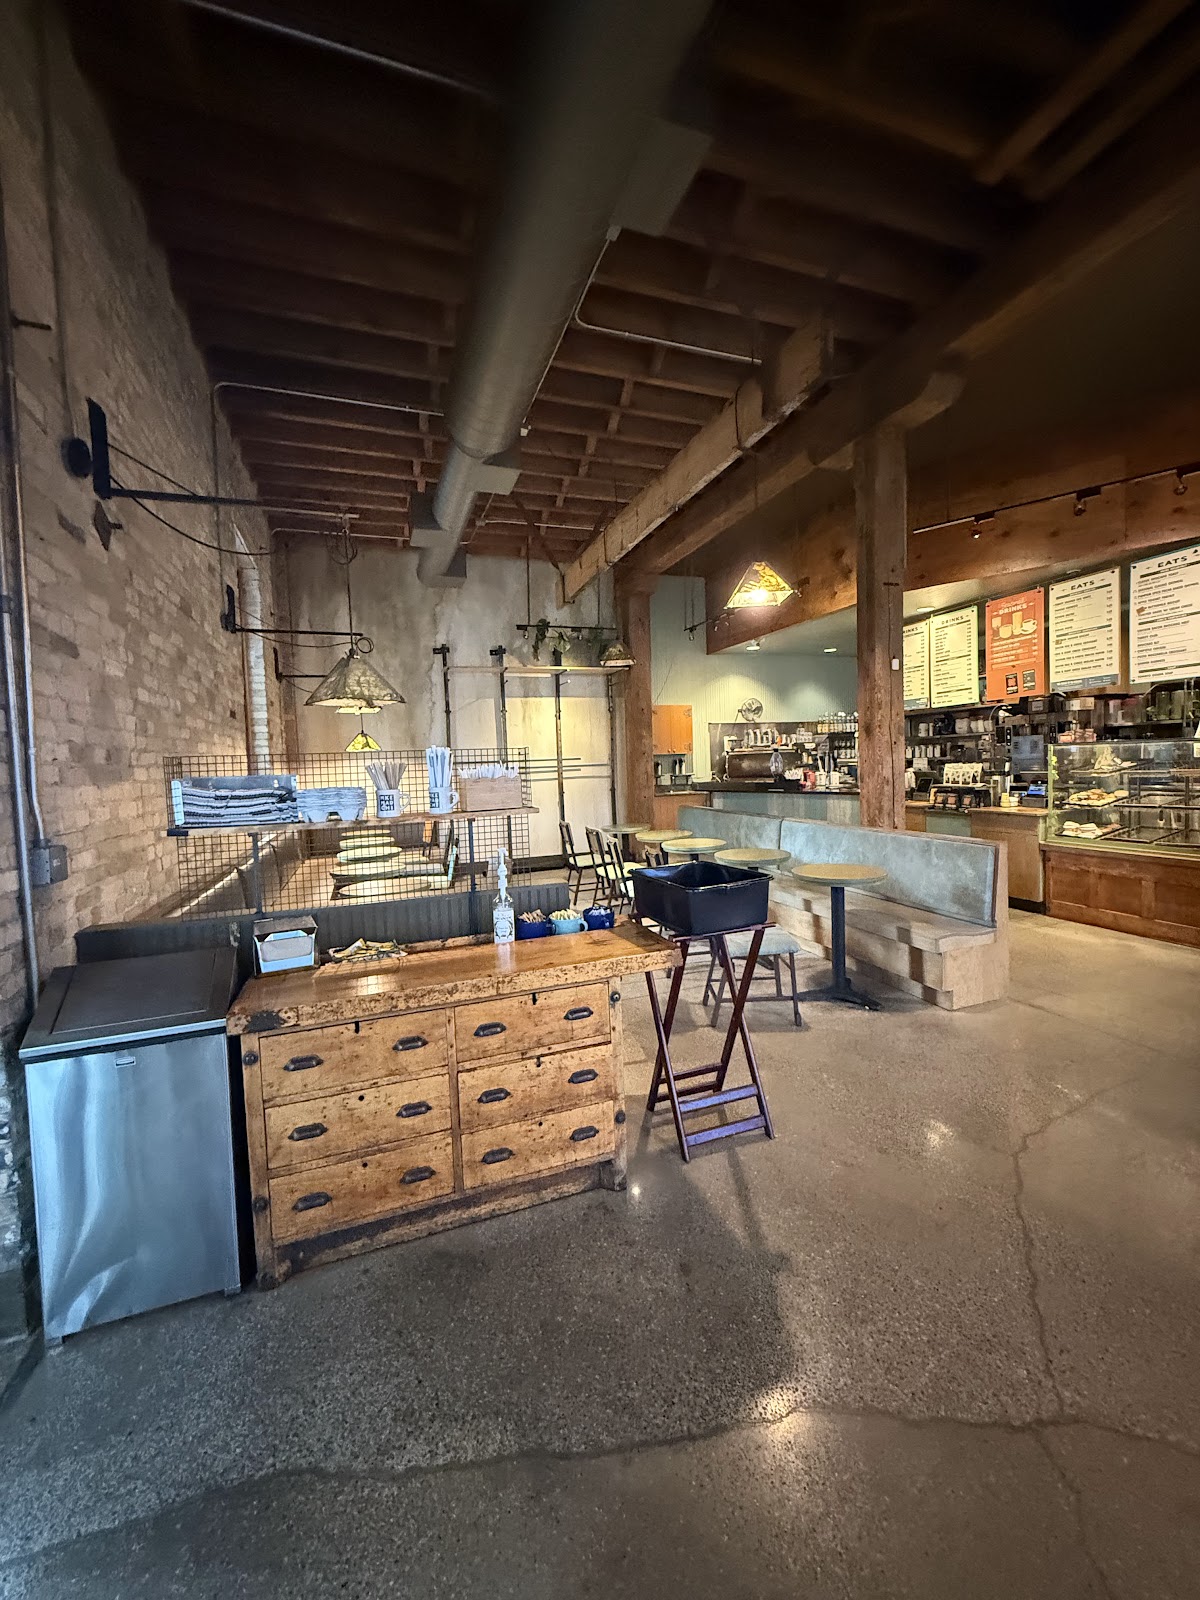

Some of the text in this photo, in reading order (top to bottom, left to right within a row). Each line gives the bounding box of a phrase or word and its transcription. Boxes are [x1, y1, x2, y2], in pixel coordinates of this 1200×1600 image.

[1157, 556, 1188, 568] EATS
[1070, 580, 1095, 590] EATS
[999, 603, 1027, 615] DRINKS
[941, 615, 964, 625] DRINKS
